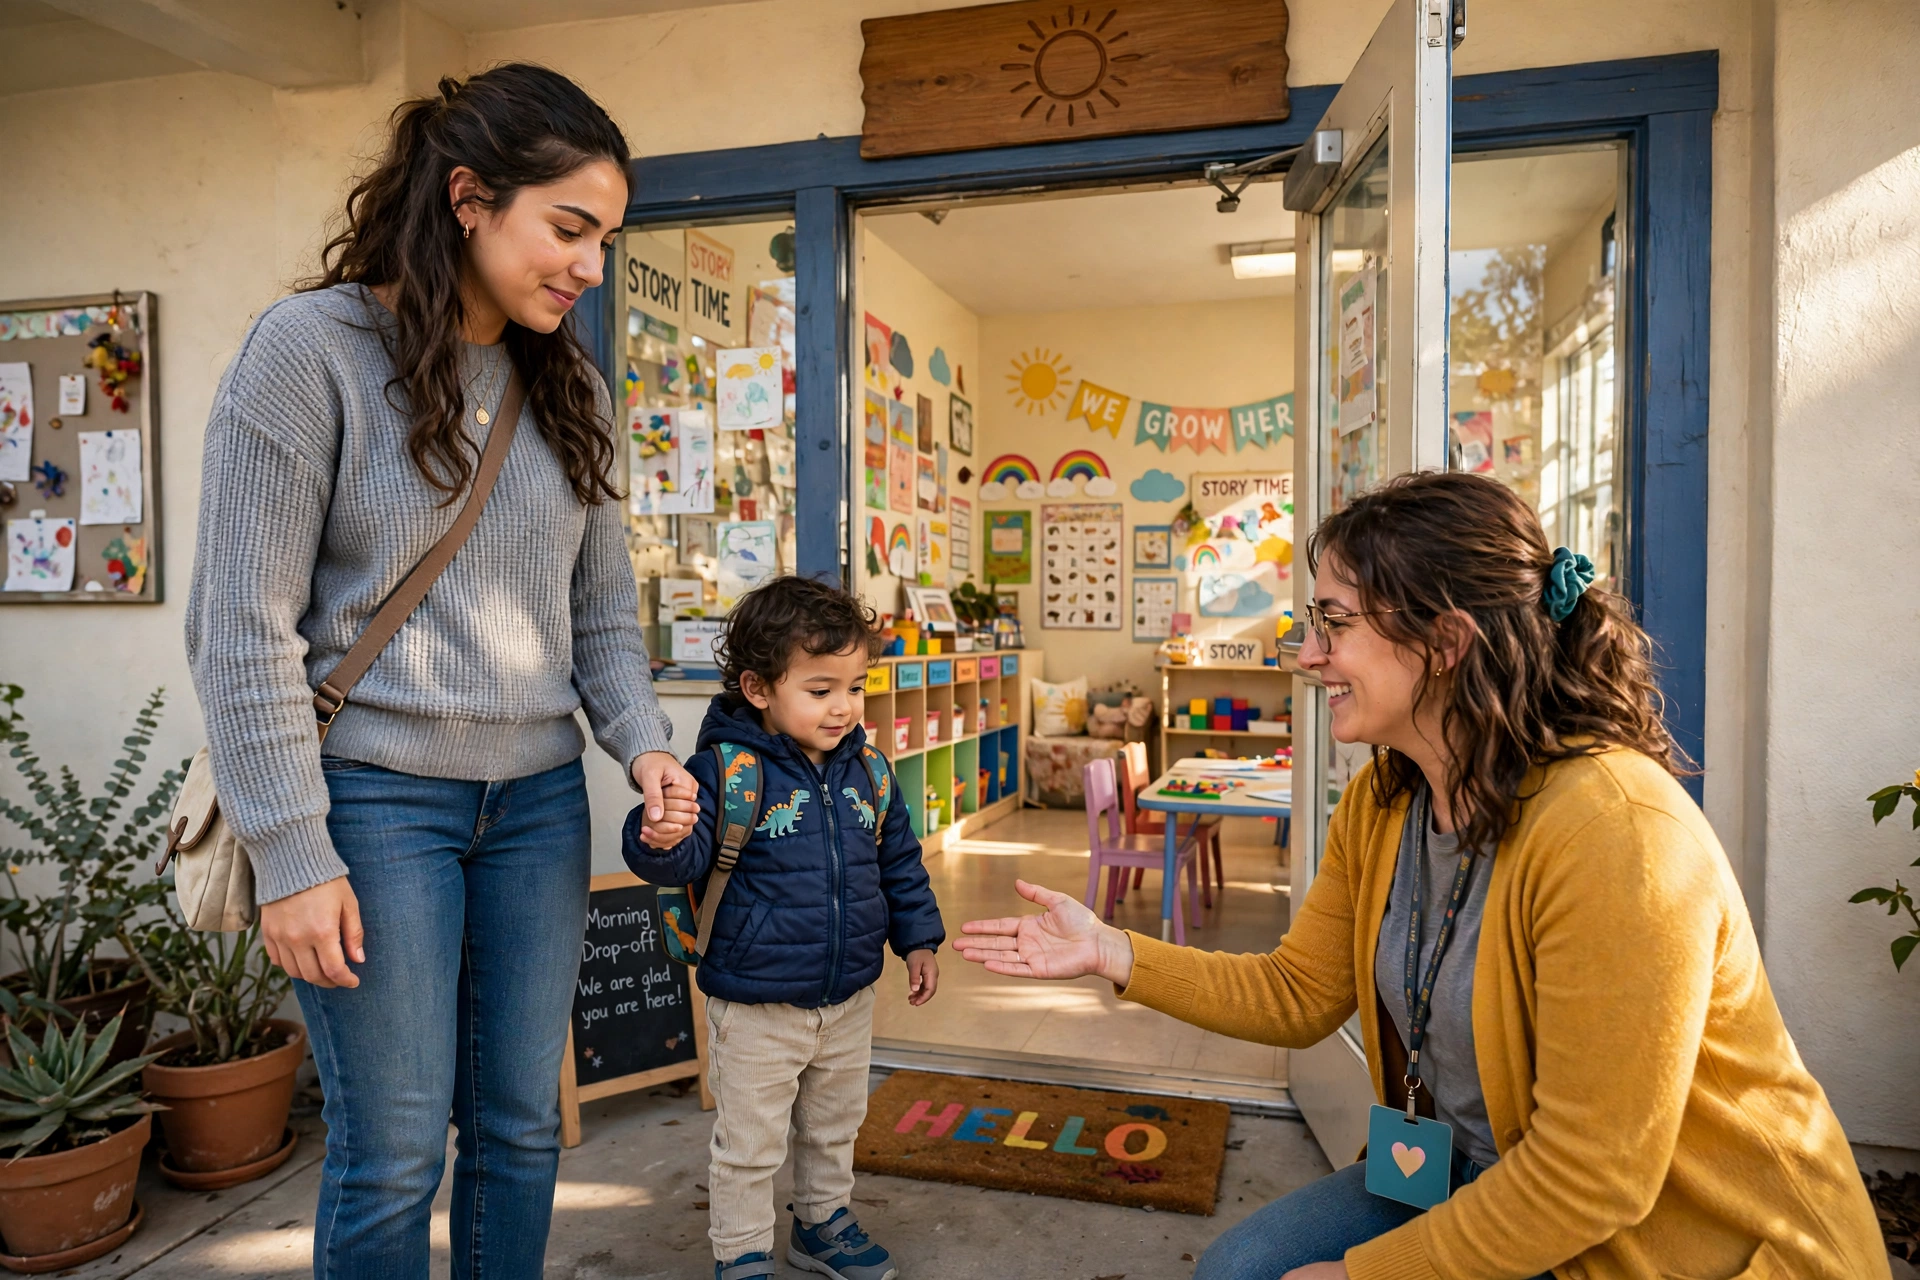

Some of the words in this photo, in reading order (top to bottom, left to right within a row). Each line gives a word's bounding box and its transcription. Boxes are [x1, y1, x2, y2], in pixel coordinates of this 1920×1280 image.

[627, 257, 682, 313] STORY
[691, 278, 731, 328] TIME
[1080, 388, 1121, 423] WE
[1143, 409, 1224, 440] GROW
[1201, 479, 1249, 496] STORY
[1253, 478, 1290, 495] TIME
[1209, 644, 1256, 660] STORY
[585, 906, 651, 931] Morning
[582, 930, 657, 964] Drop-off
[578, 976, 603, 997] We
[610, 976, 635, 991] are
[641, 964, 672, 993] glad
[581, 1006, 609, 1029] you
[615, 1000, 640, 1015] are
[645, 984, 682, 1009] here!
[894, 1099, 1168, 1162] HELLO
